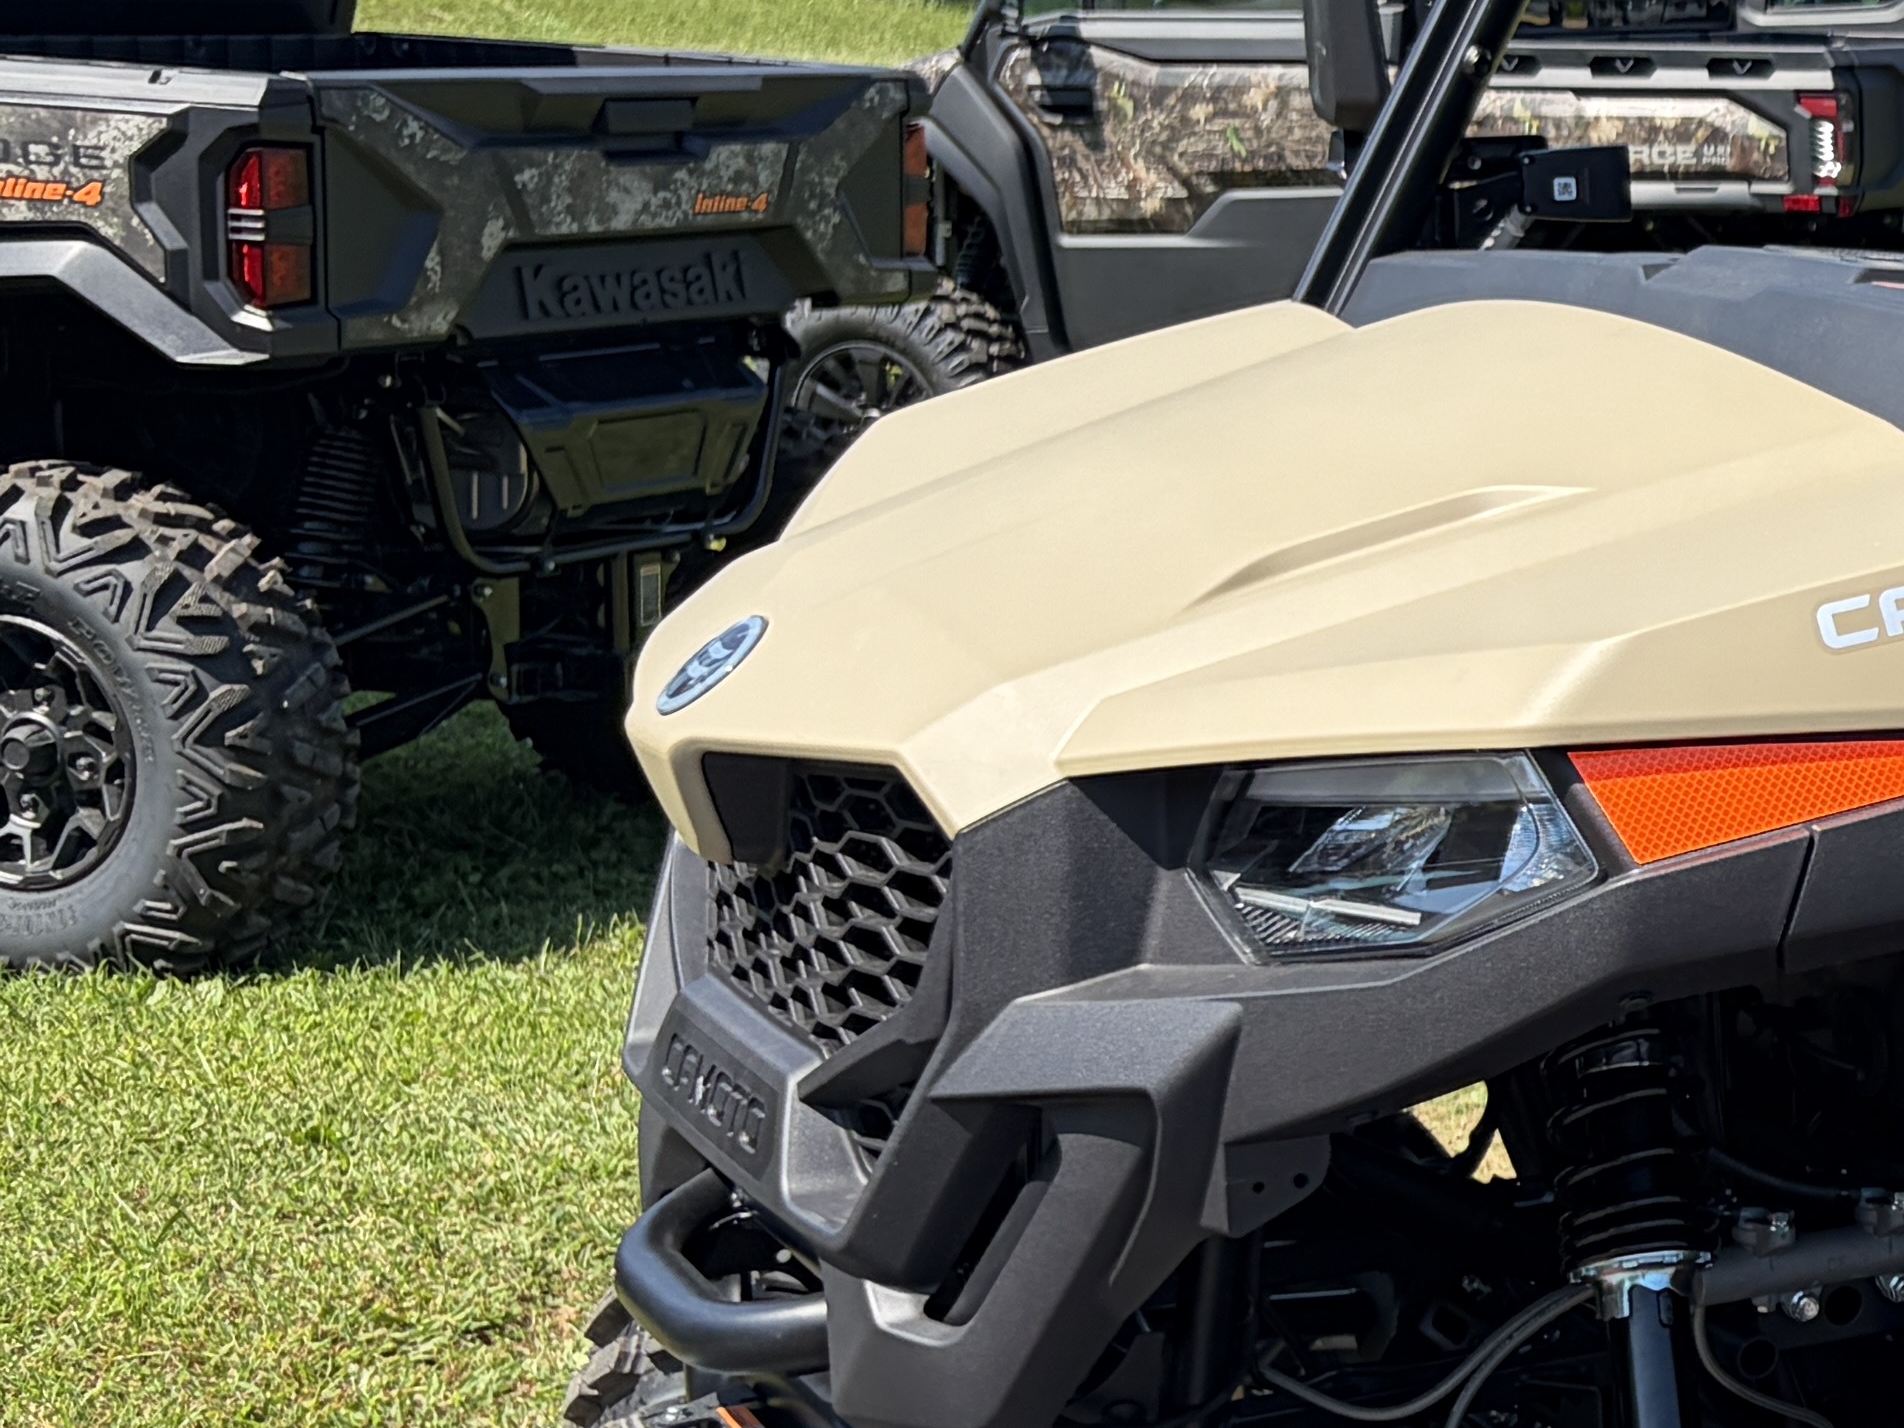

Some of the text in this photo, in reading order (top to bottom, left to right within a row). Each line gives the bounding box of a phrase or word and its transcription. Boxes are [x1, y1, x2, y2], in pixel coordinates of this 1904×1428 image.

[0, 177, 105, 208] line-4
[513, 249, 747, 320] Kawasaki
[661, 1032, 767, 1155] CFMOTO
